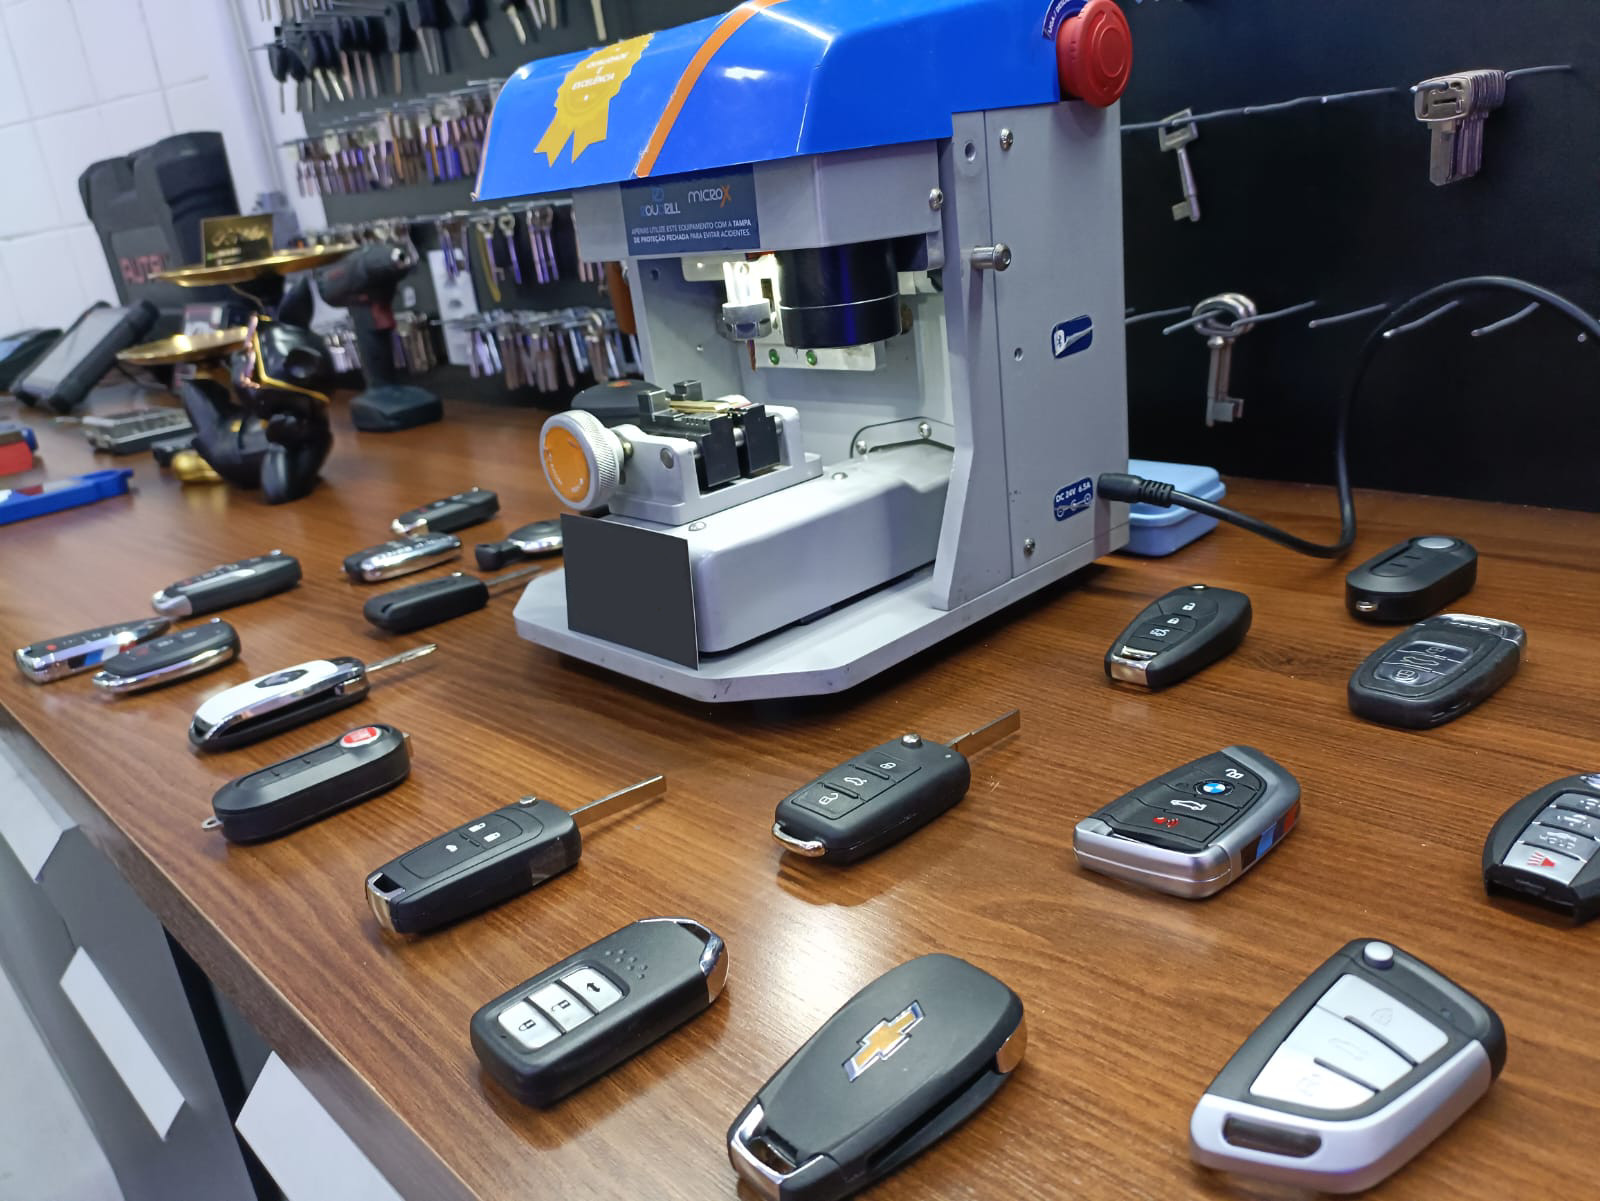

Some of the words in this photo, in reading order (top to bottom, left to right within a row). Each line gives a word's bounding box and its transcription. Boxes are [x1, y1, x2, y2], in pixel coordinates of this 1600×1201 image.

[678, 223, 713, 232] EQUIPAMENTO
[714, 221, 727, 229] COM
[634, 236, 640, 244] DE
[641, 234, 665, 242] PROTEÇÃO
[1056, 492, 1065, 502] DC
